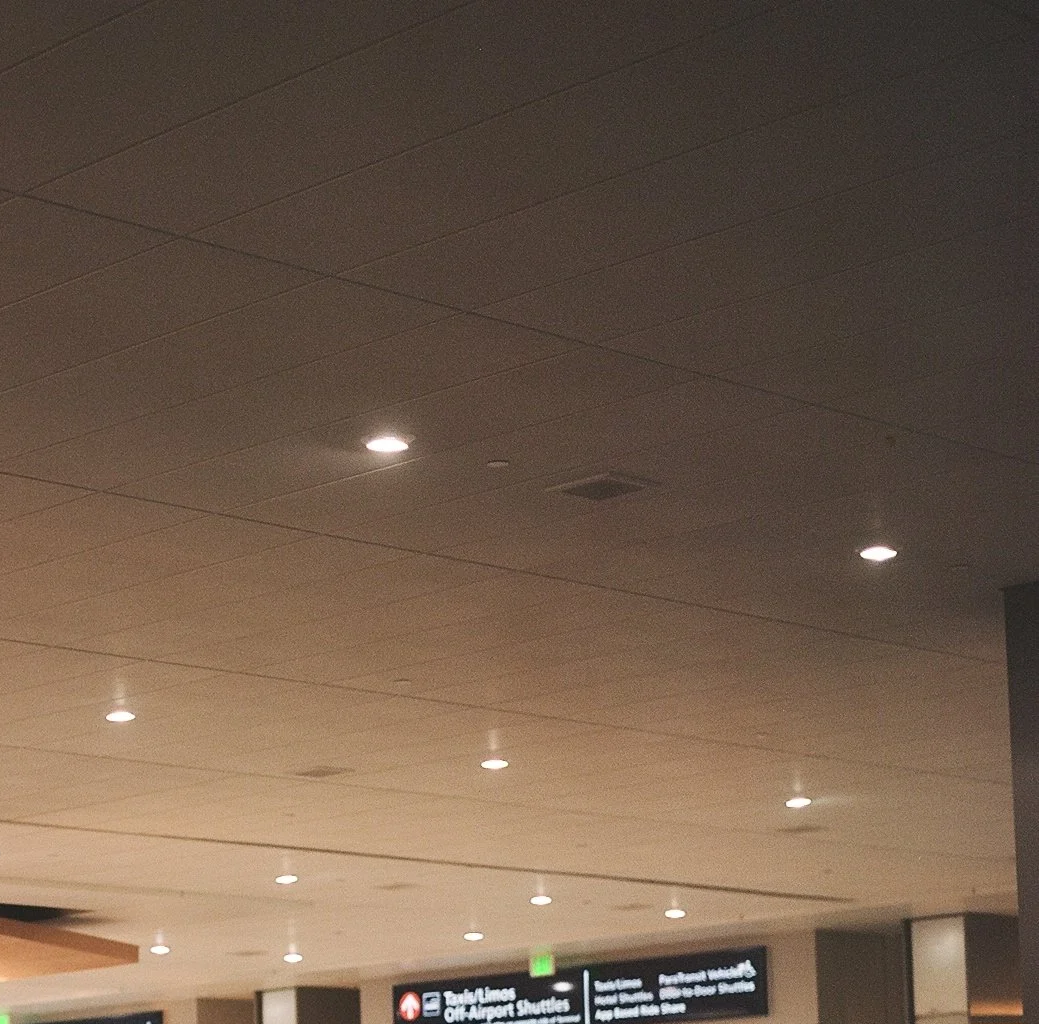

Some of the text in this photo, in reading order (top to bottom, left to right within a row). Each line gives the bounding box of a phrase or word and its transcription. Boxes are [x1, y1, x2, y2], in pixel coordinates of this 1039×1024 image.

[443, 987, 516, 1006] Taxis/Limos
[444, 996, 570, 1023] Off-Airport Shuttles
